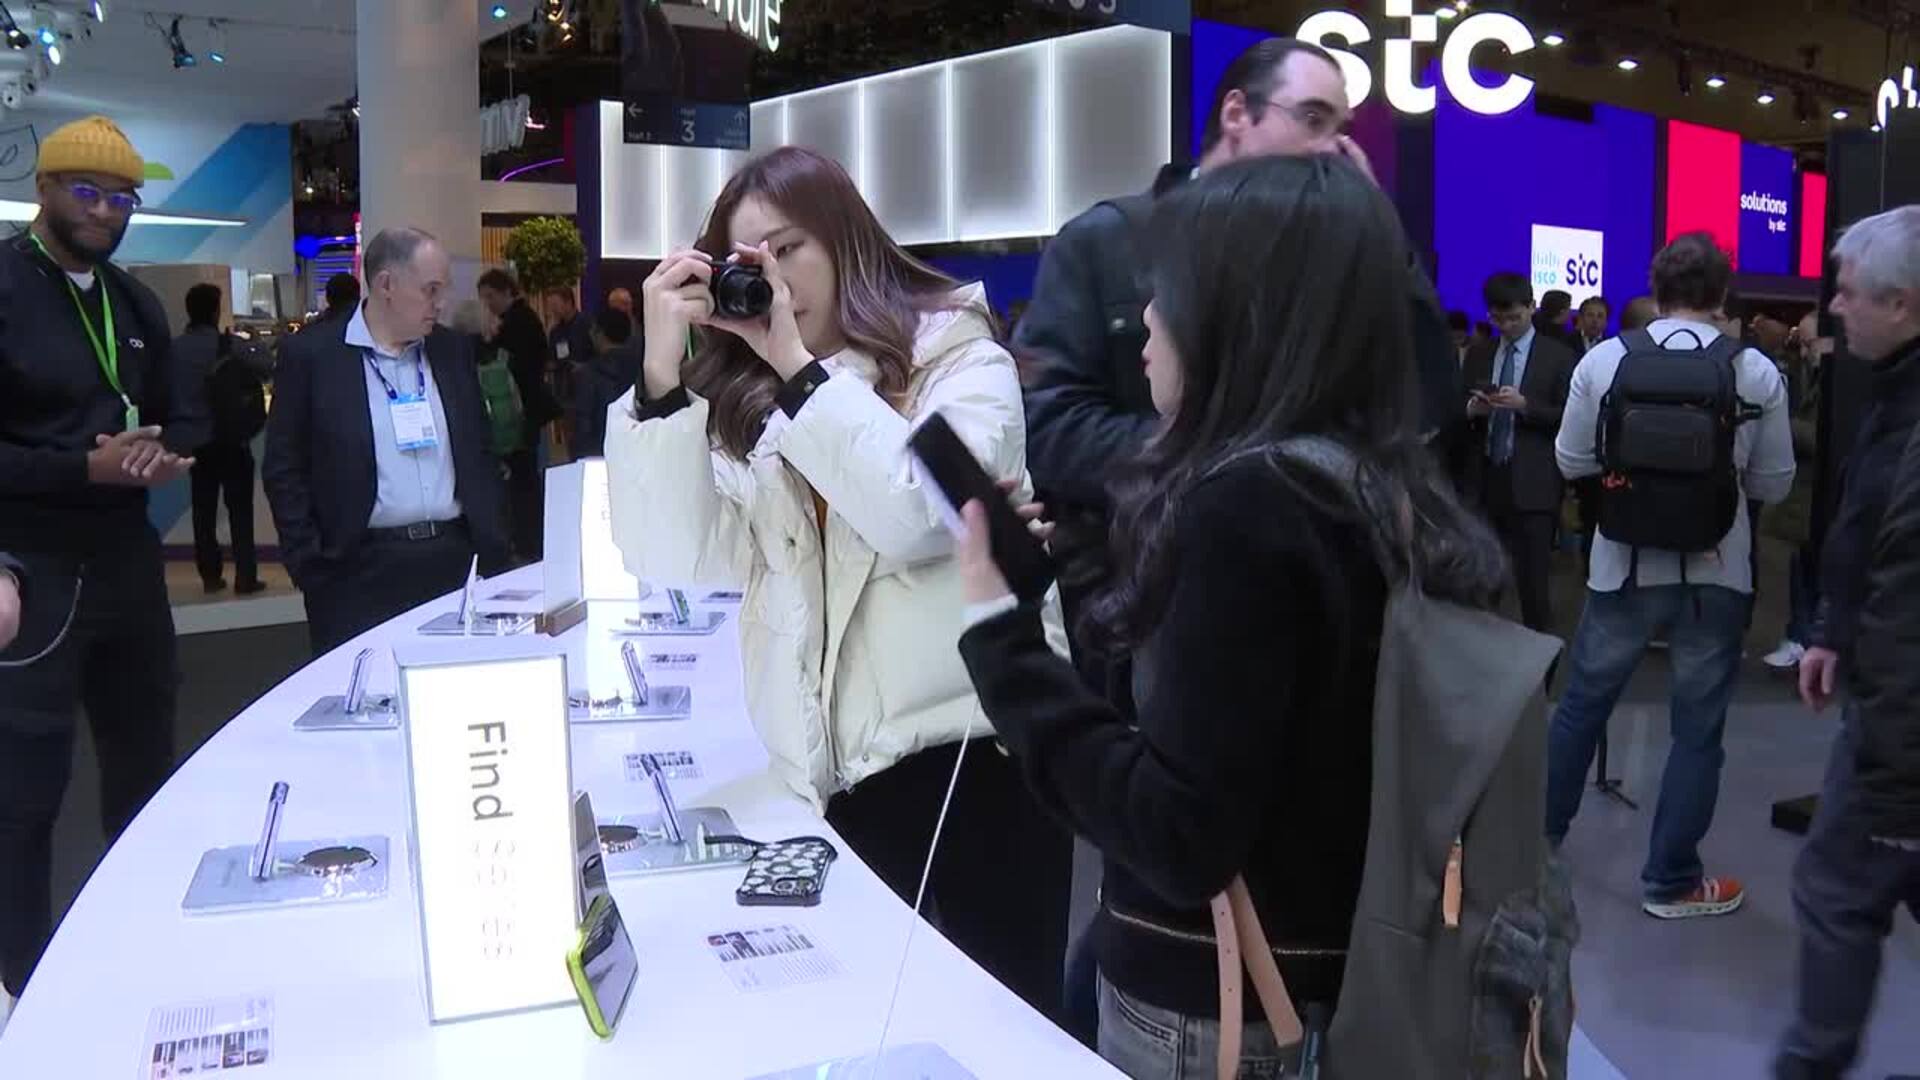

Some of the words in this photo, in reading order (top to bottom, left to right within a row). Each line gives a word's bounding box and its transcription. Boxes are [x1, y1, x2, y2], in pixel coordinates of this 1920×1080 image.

[1295, 0, 1535, 115] stc
[681, 120, 696, 142] 3
[1740, 190, 1787, 215] solutions
[1566, 253, 1599, 286] stc
[467, 720, 514, 821] Find
